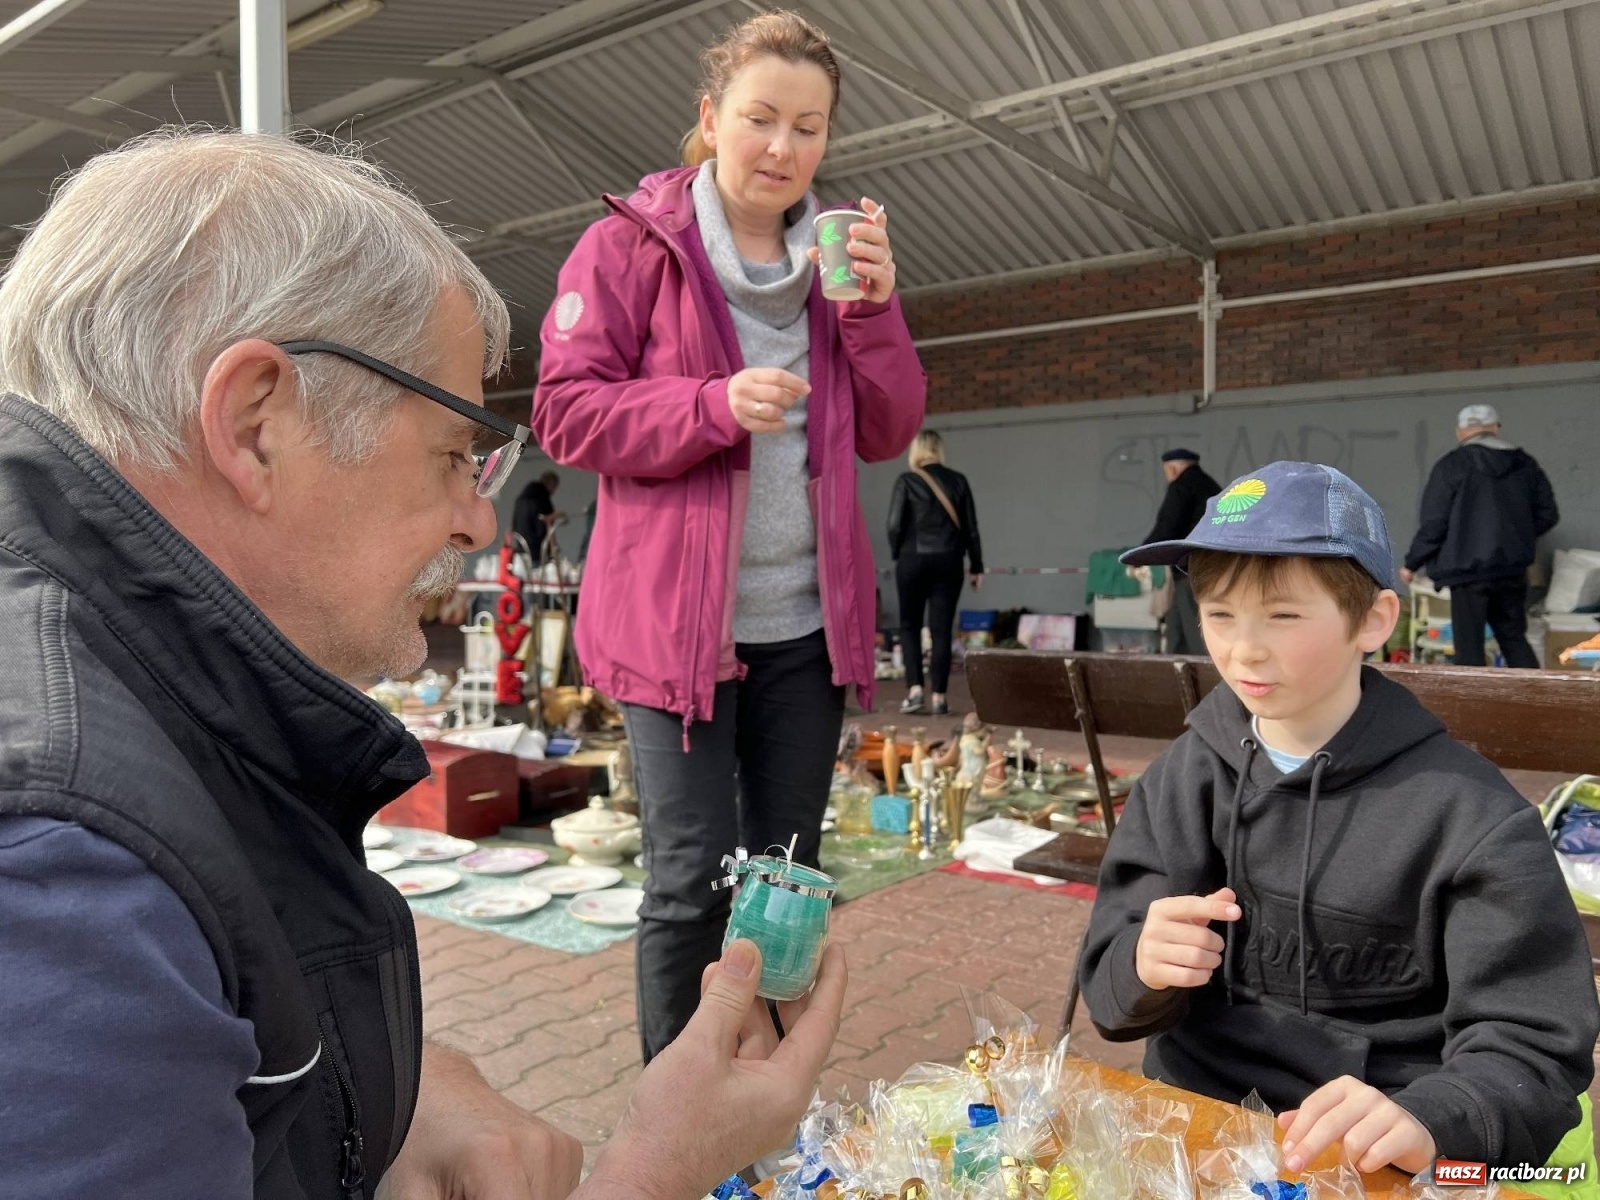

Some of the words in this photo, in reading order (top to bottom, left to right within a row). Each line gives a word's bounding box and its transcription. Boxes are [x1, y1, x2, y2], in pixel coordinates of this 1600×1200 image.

[1211, 515, 1227, 525] TOP
[1227, 514, 1247, 523] GEN
[495, 545, 531, 706] LOVE
